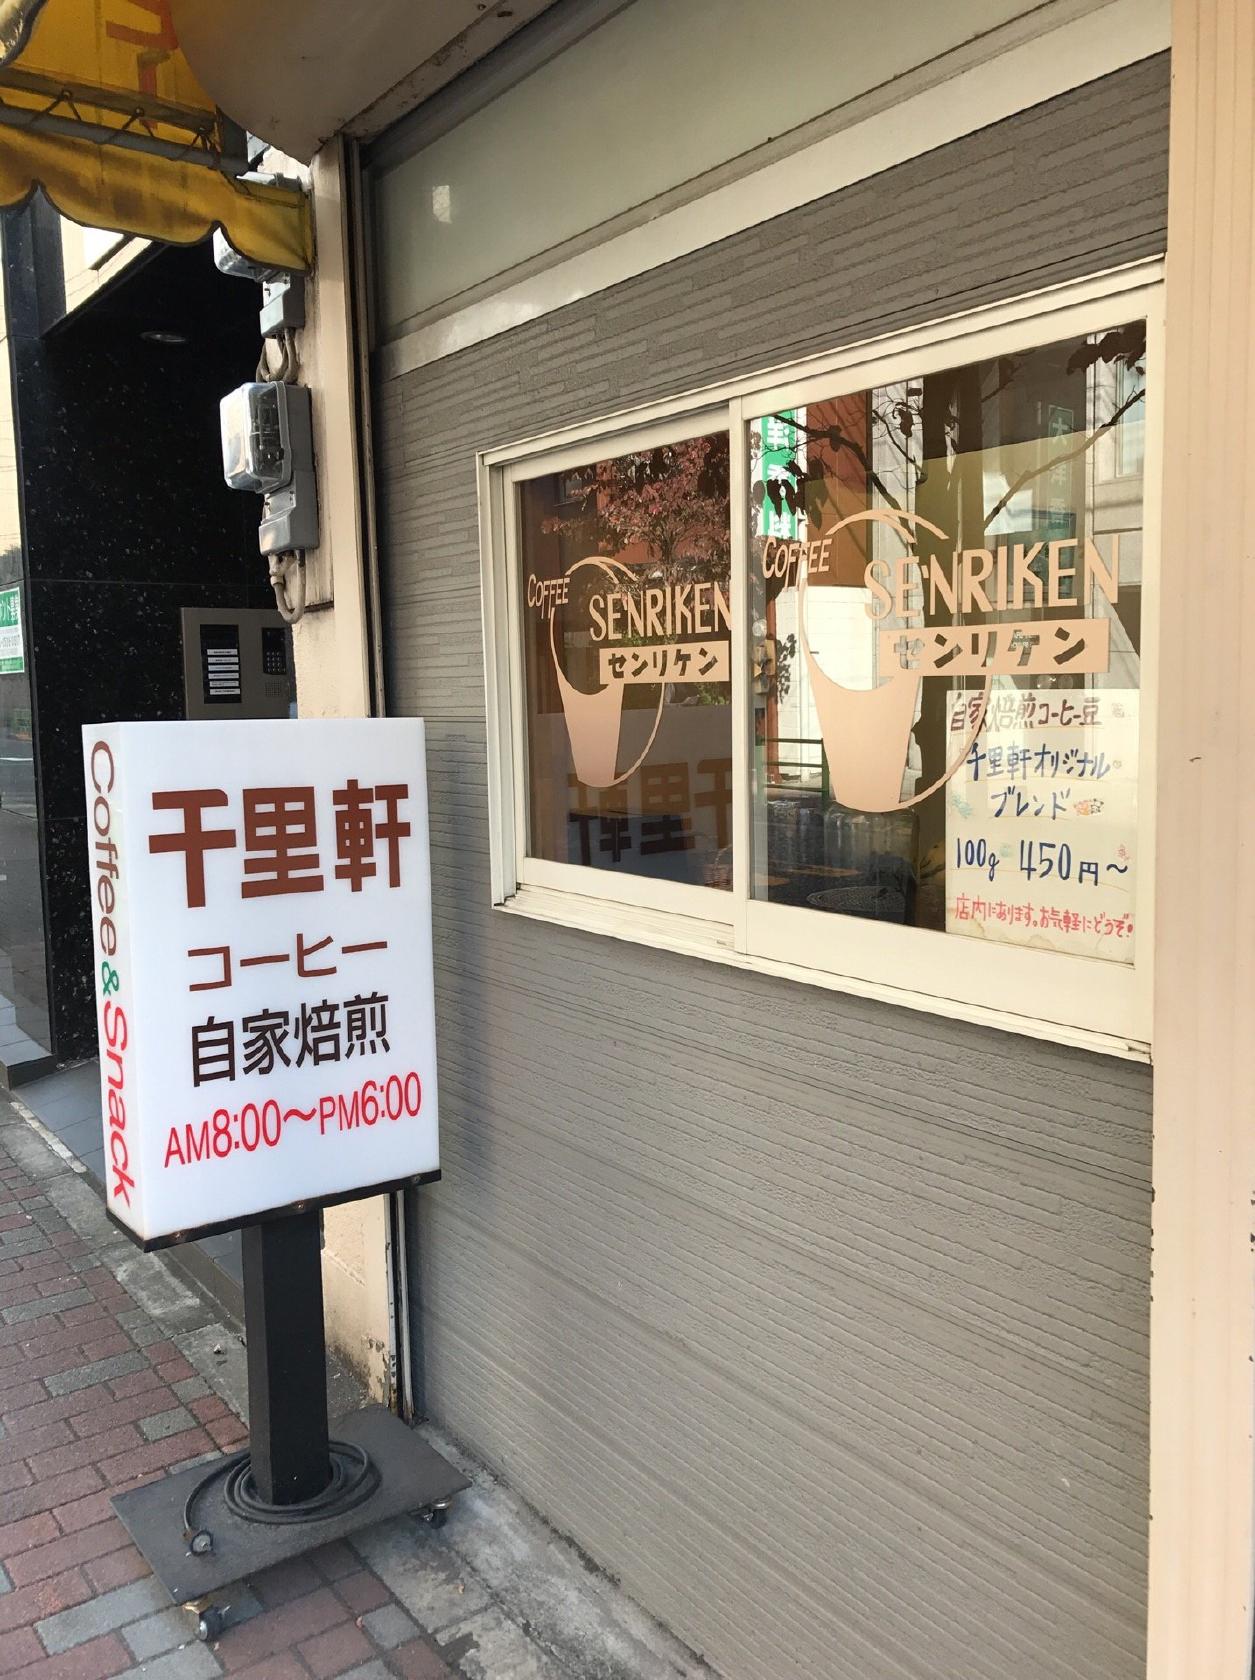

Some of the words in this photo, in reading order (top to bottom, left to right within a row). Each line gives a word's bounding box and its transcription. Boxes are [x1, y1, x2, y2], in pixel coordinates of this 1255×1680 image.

[763, 535, 832, 593] COFFEE
[864, 534, 1121, 620] SENRIKEN
[528, 574, 570, 619] COFFEE
[608, 647, 718, 679] センリケン
[894, 627, 1086, 669] センリケン
[951, 692, 1103, 732] 自家焙煎コーヒー豆
[967, 741, 1111, 781] 千里軒オリジナル
[991, 785, 1071, 820] ブレンド
[91, 740, 119, 956] Coffee
[148, 779, 411, 908] 千里軒
[957, 838, 1000, 882] 100g
[101, 961, 119, 997] &
[187, 933, 388, 992] コーヒー
[191, 991, 391, 1088] 自家焙煎
[103, 1000, 135, 1208] Snack
